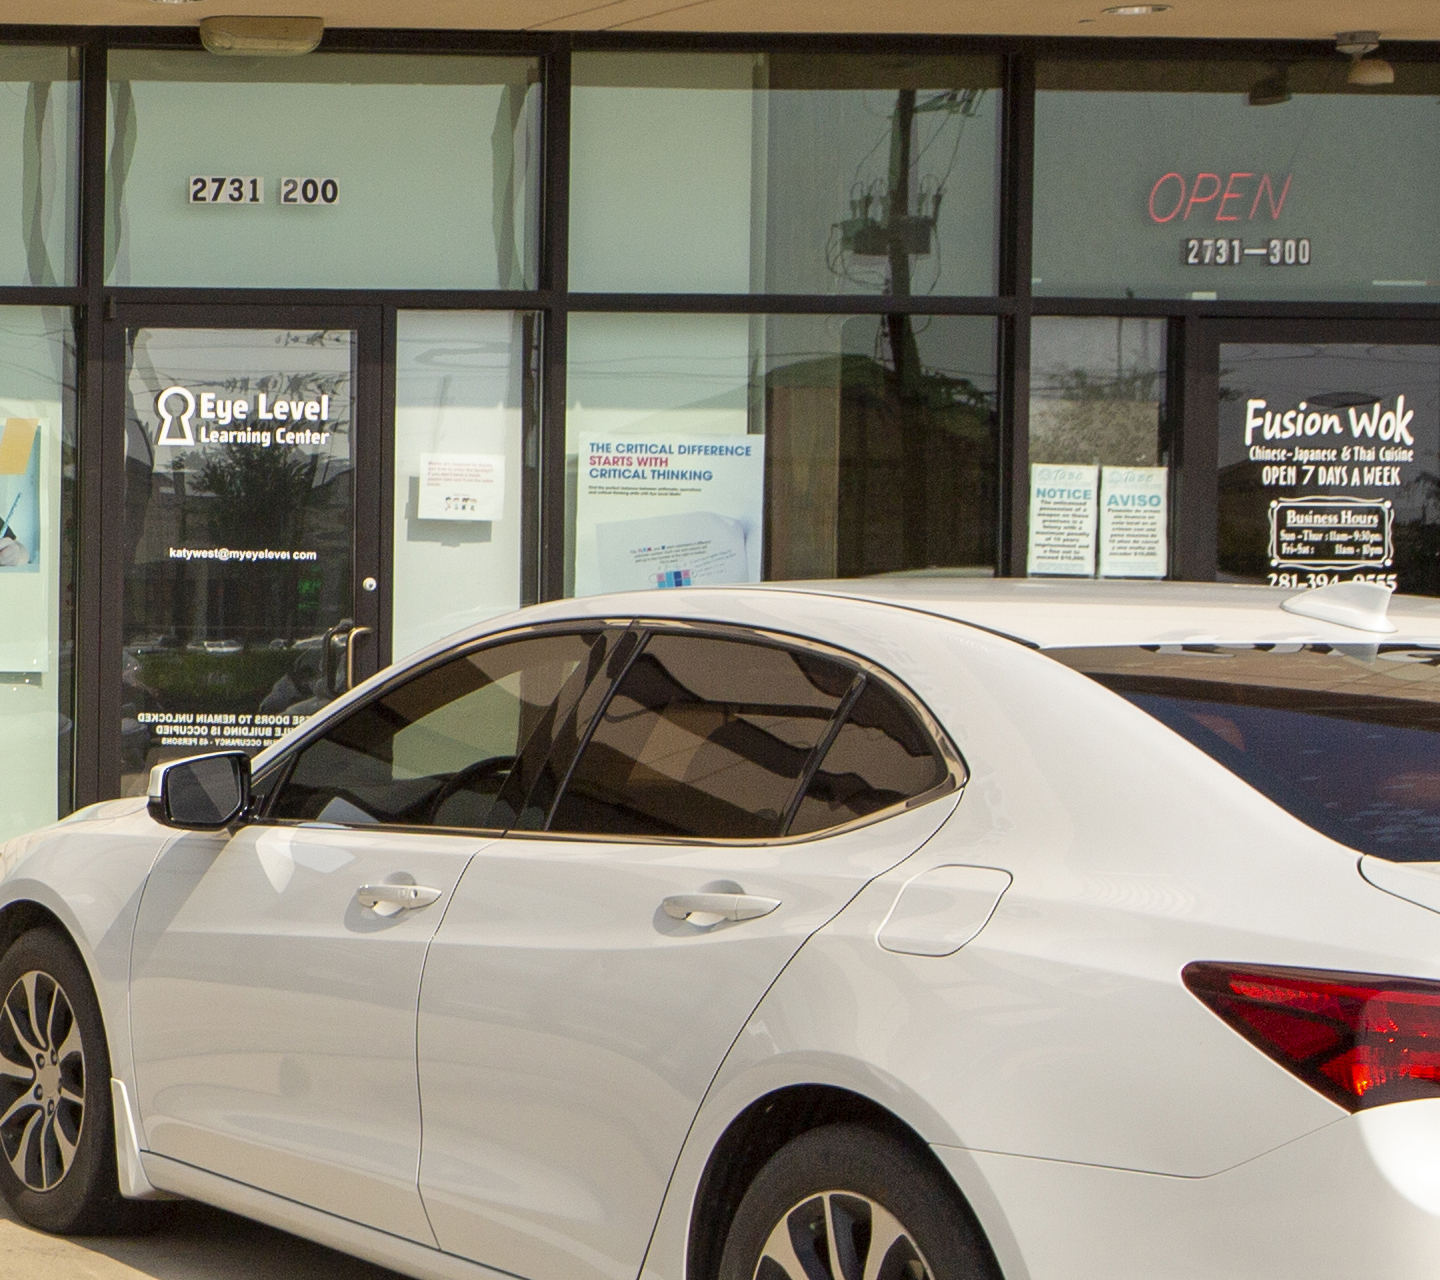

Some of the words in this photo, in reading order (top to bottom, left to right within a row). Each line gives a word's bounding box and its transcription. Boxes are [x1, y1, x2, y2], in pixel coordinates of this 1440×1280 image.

[192, 178, 260, 202] 2731
[283, 179, 338, 203] 200
[1148, 172, 1293, 223] OPEN
[200, 392, 249, 425] Eye
[258, 393, 329, 421] Level
[1244, 398, 1343, 446] Fusion
[1348, 394, 1415, 446] Wok
[200, 426, 271, 447] Learning
[275, 427, 330, 445] Center
[589, 442, 612, 453] THE
[615, 443, 674, 455] CRITICAL
[678, 444, 752, 457] DIFFERENCE
[1248, 445, 1338, 464] Chinese-Japanese
[1340, 446, 1352, 462] &
[1353, 446, 1376, 462] Thai
[1379, 446, 1414, 462] Cuisine
[589, 455, 633, 467] STARTS
[636, 456, 669, 468] WITH
[589, 468, 647, 480] CRITICAL
[650, 469, 713, 481] THINKING
[1262, 465, 1297, 486] OPEN
[1301, 465, 1315, 486] 7
[1317, 465, 1348, 486] DAYS
[1350, 466, 1360, 486] A
[1362, 466, 1401, 487] WEEK
[1036, 487, 1092, 500] NOTICE
[1106, 494, 1162, 507] AVISO
[1286, 510, 1339, 525] Business
[1340, 510, 1379, 525] Hours
